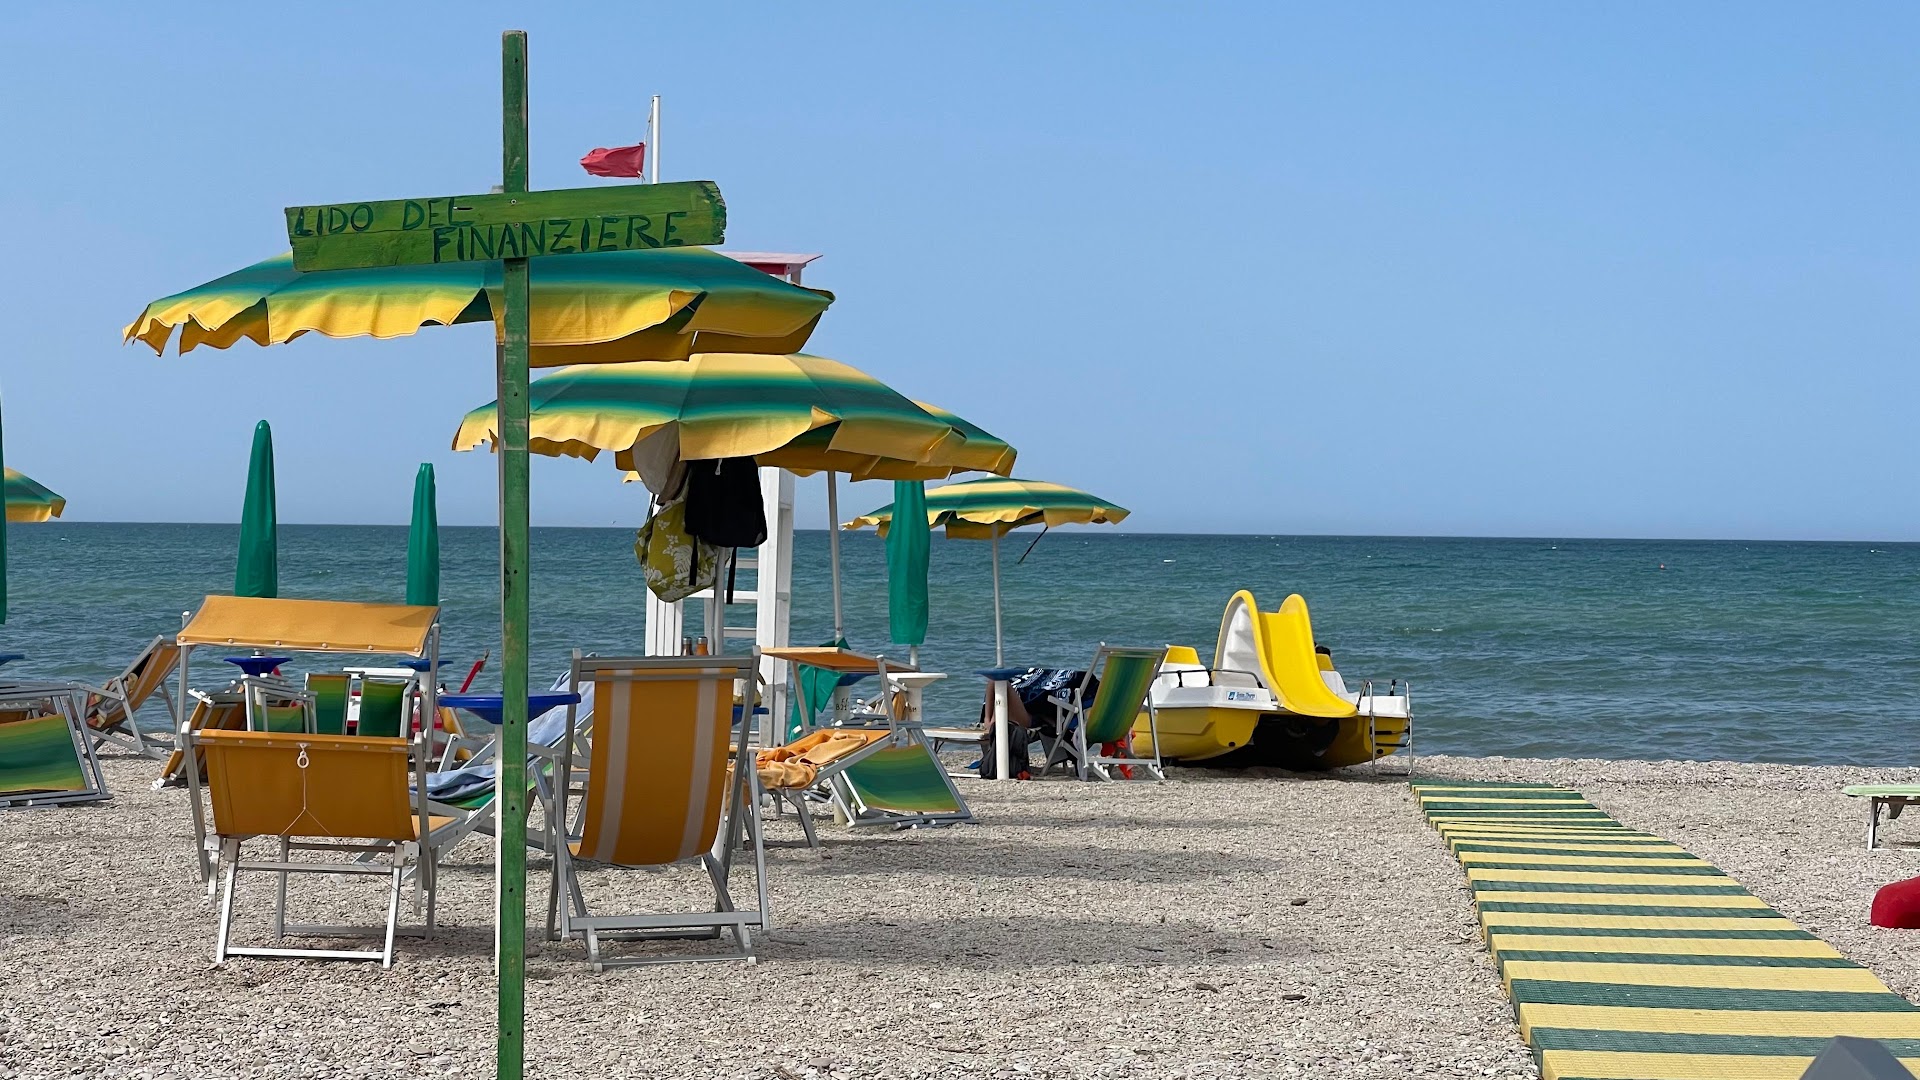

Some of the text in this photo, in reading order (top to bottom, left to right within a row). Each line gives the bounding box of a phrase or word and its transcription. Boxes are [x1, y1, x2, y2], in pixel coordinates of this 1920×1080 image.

[294, 197, 475, 237] LIDO DEL
[433, 211, 688, 264] FINANZIERE
